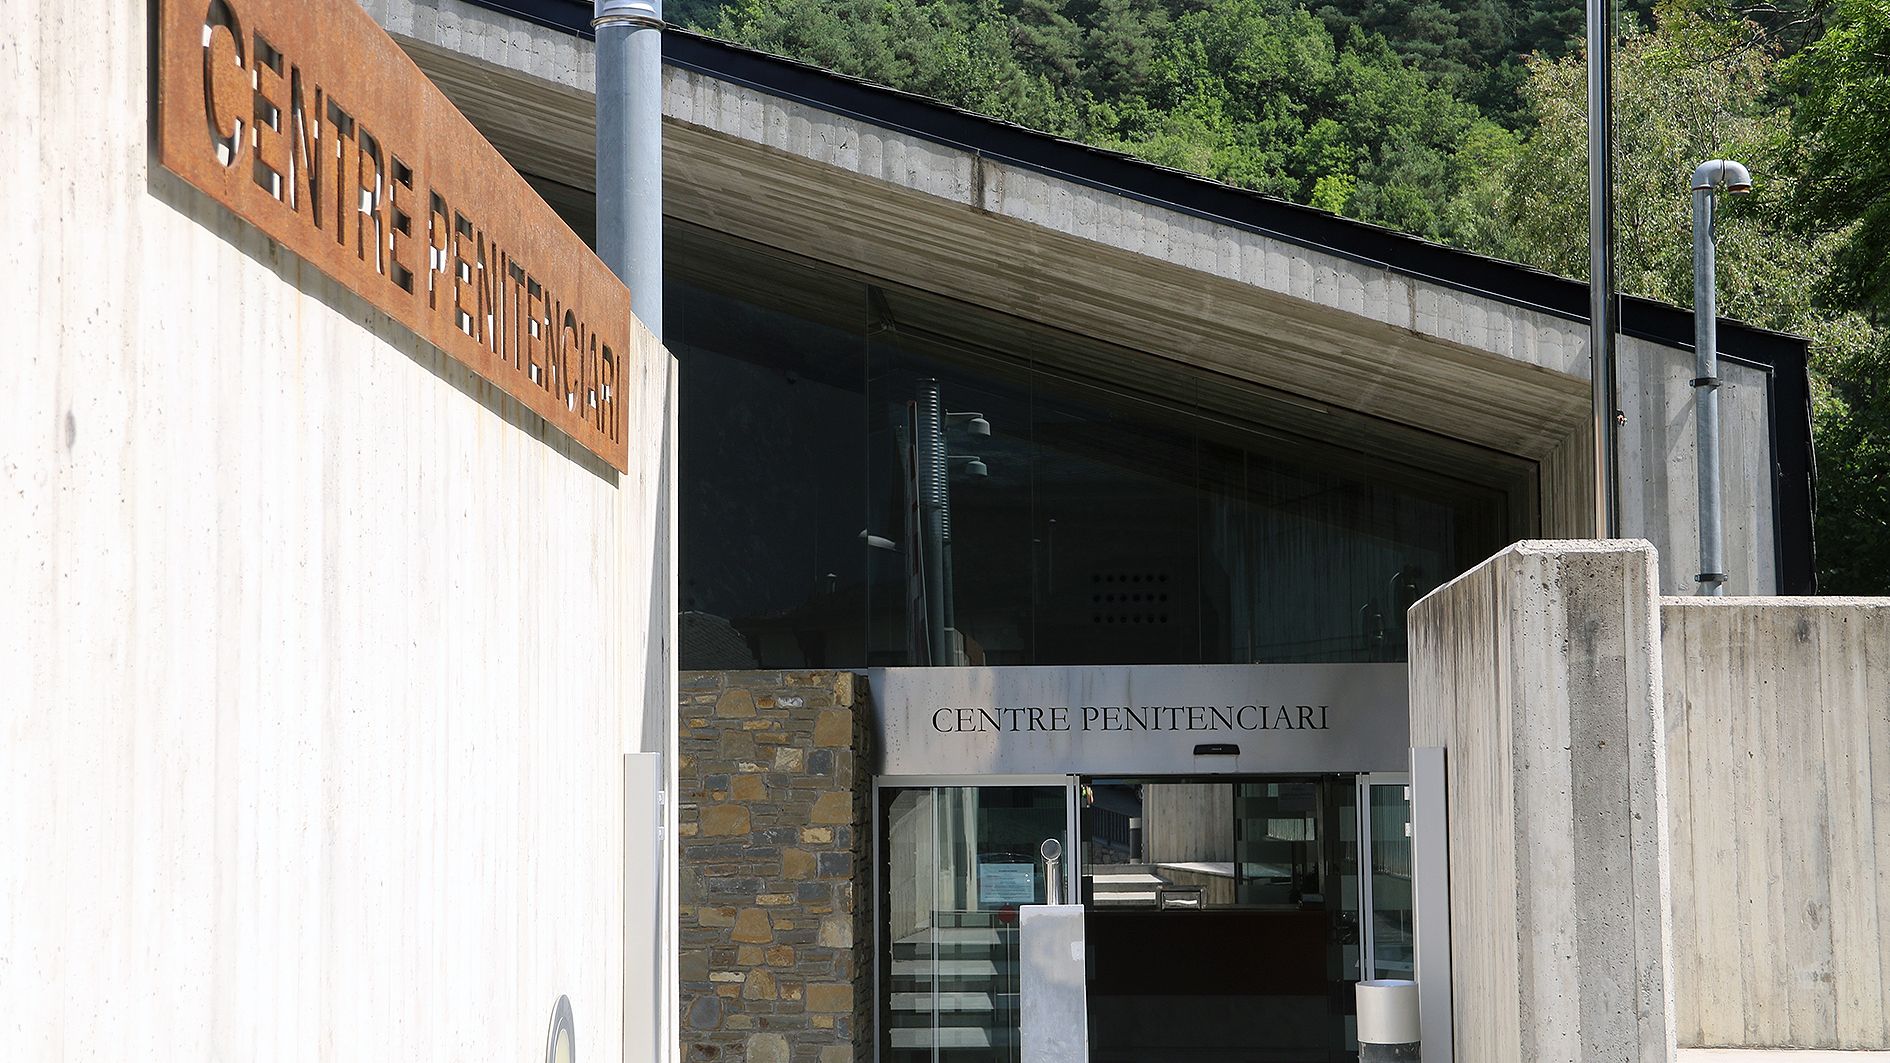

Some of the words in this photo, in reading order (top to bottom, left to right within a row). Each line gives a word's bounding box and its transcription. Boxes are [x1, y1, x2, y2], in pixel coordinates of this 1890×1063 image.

[203, 0, 414, 295] CENTRE
[429, 186, 621, 445] PENITENCIARI
[931, 706, 1070, 733] CENTRE
[1080, 704, 1329, 732] PENITENCIARI
